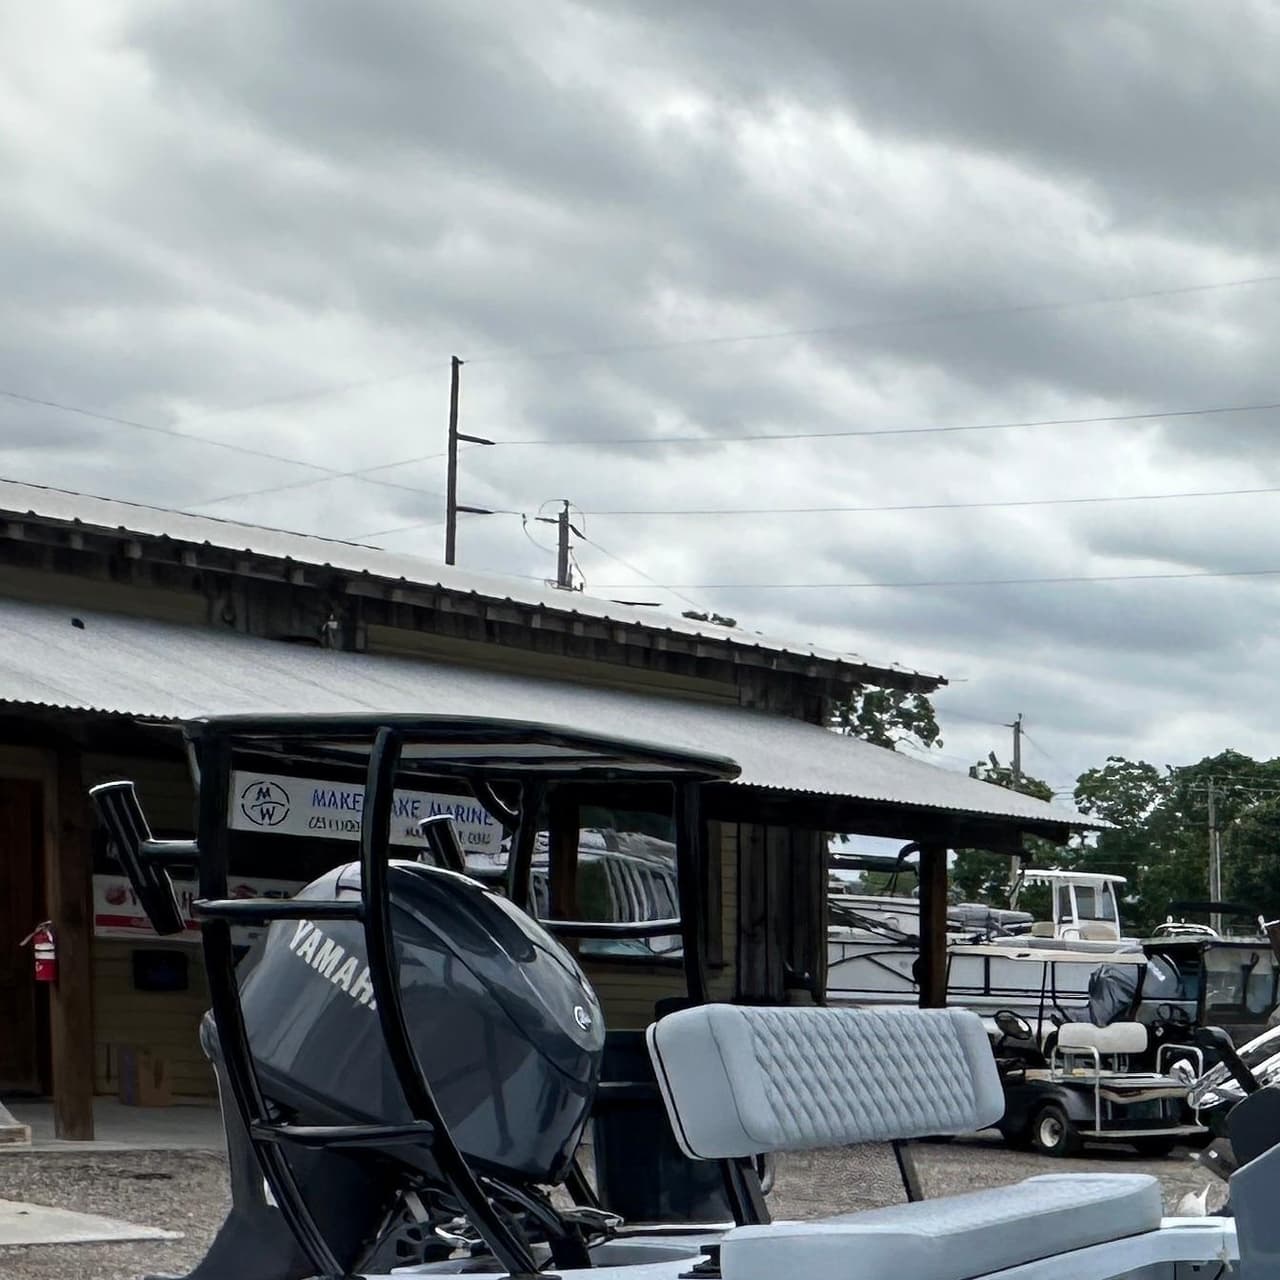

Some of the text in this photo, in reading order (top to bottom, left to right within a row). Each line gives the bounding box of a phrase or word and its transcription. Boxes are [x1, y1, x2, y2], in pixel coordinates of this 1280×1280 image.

[312, 789, 364, 812] MAKE
[259, 806, 276, 822] W
[289, 919, 378, 1010] YAMAH
